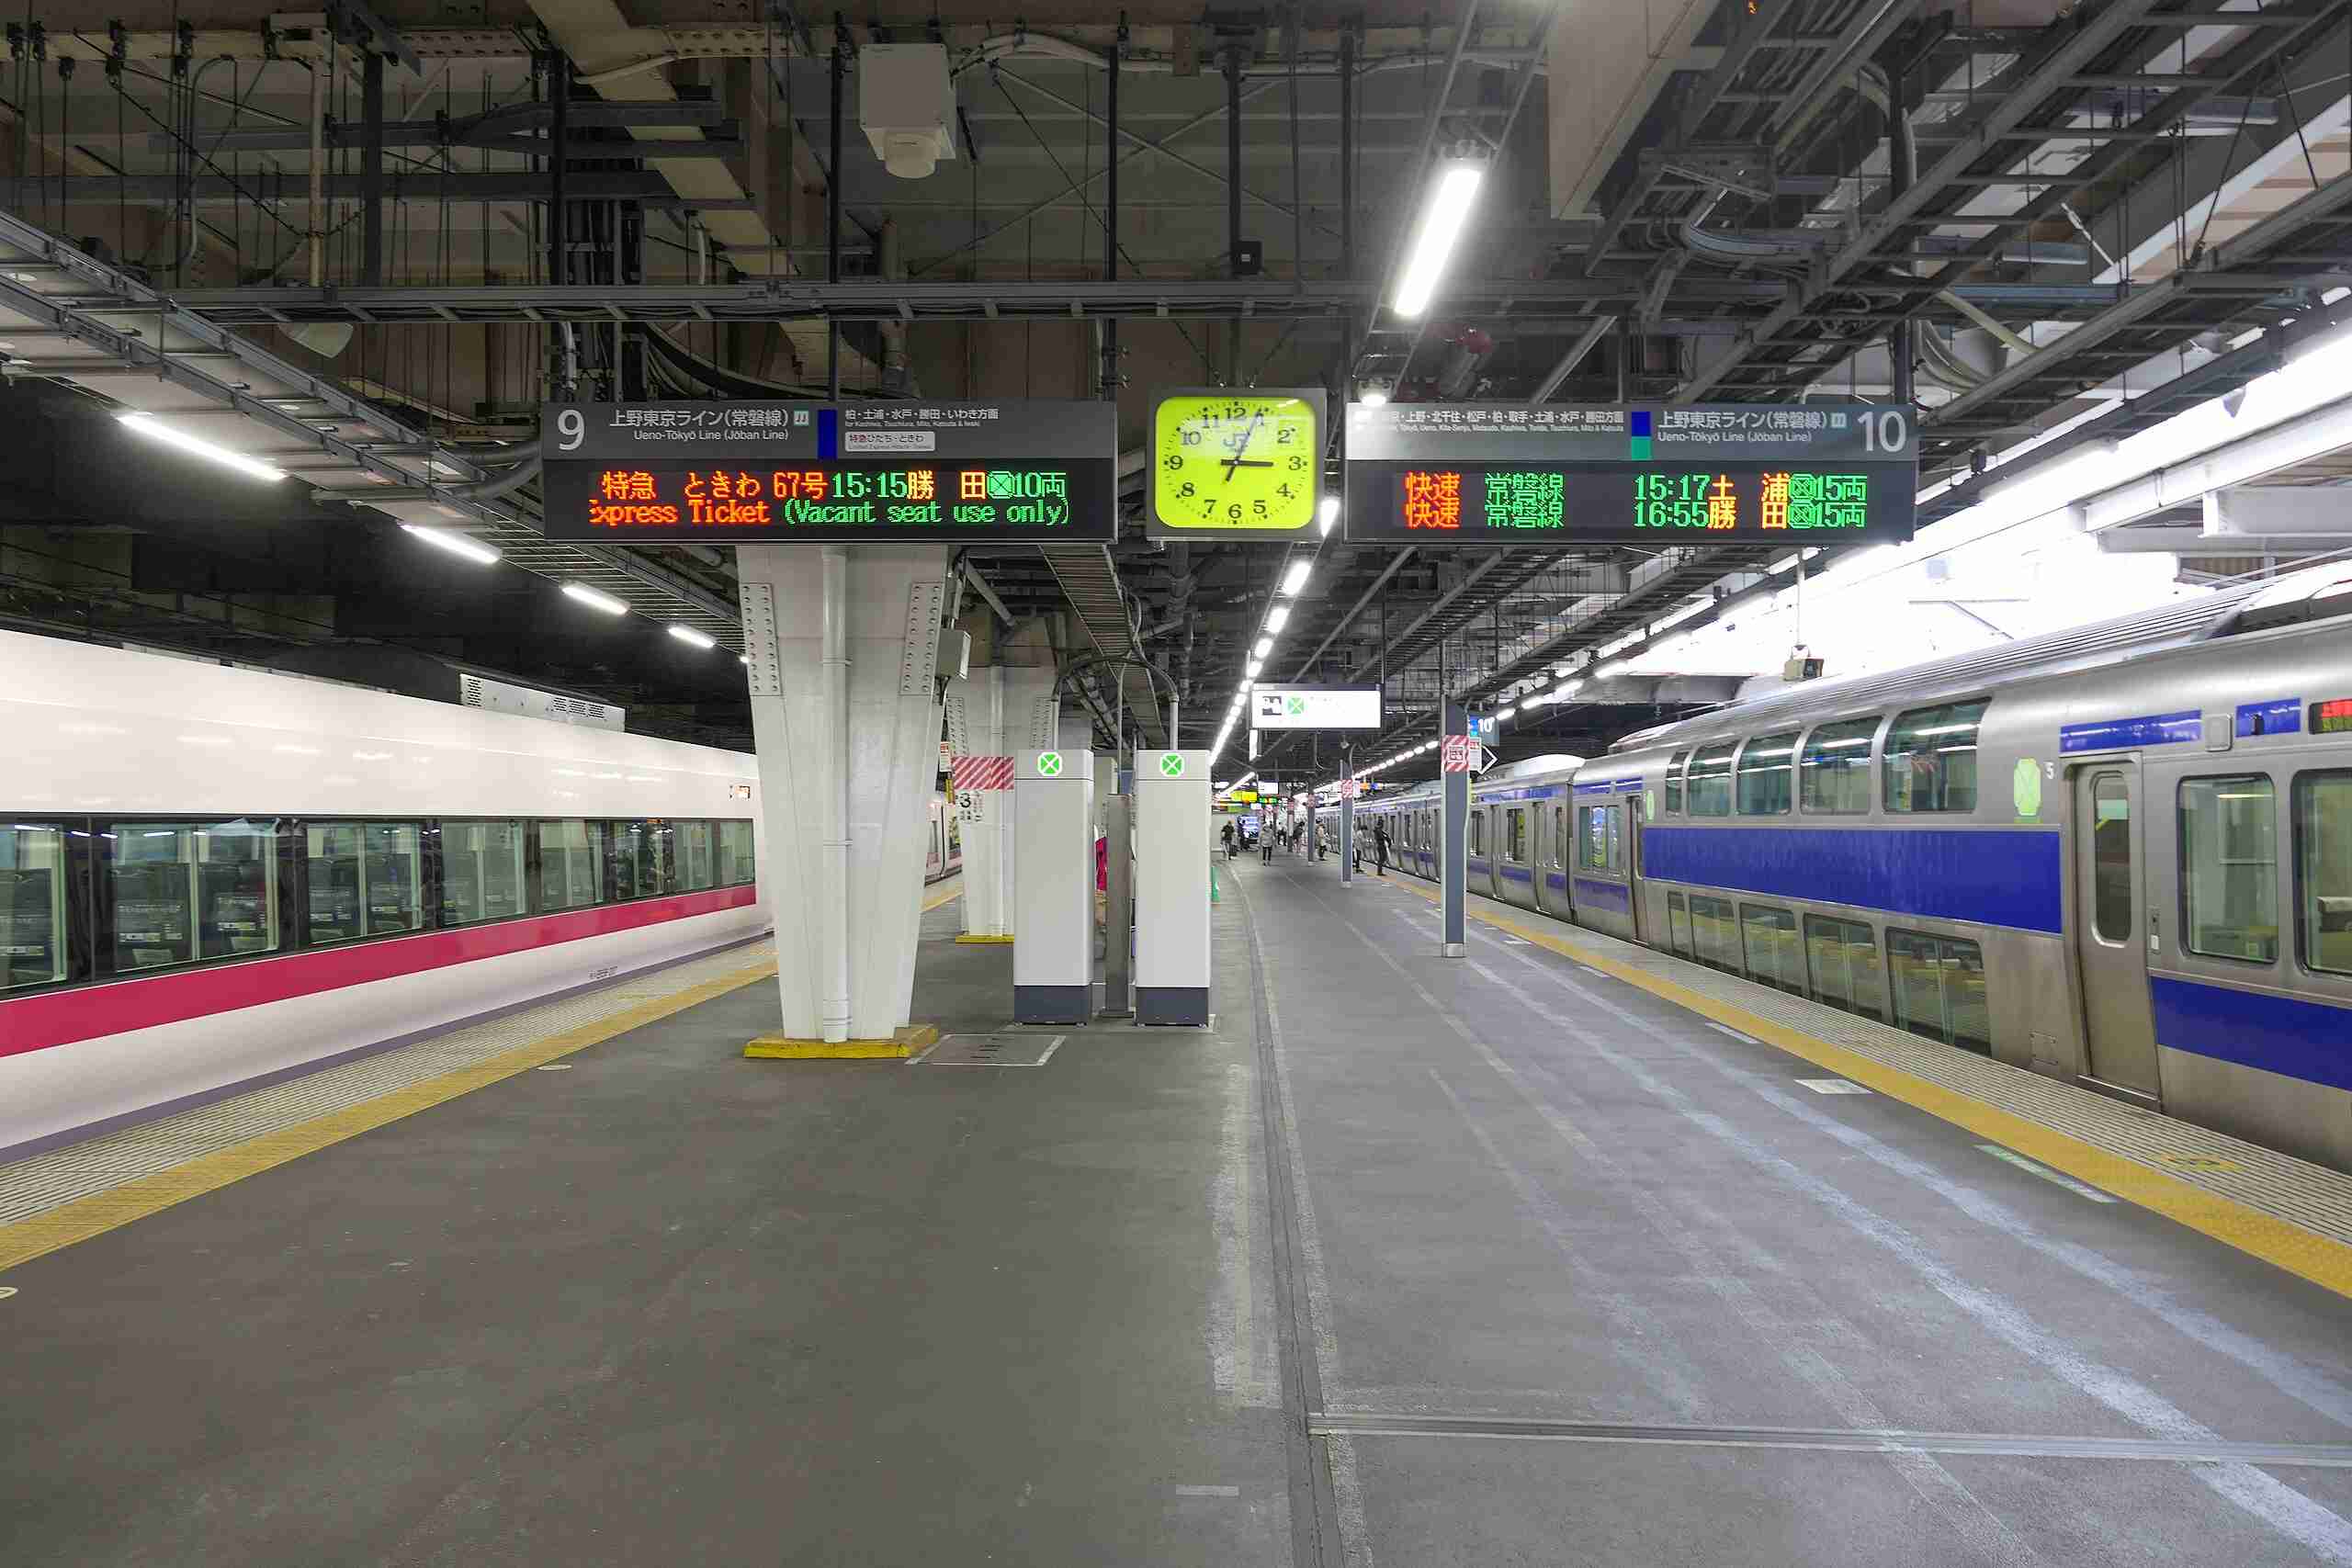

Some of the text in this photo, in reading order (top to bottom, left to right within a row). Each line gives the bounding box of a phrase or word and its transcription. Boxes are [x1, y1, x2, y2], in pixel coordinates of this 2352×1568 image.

[1225, 407, 1247, 420] 12
[1202, 414, 1220, 428] 11
[558, 410, 585, 450] 9
[699, 430, 721, 440] Line
[763, 429, 788, 441] Line)
[1277, 429, 1291, 444] 2
[1858, 411, 1906, 452] 10
[1182, 431, 1202, 446] 10
[1723, 433, 1745, 442] Line
[1786, 432, 1812, 443] Line)
[1170, 456, 1183, 469] 9
[1288, 457, 1302, 470] 3
[602, 471, 656, 500] 特急
[684, 471, 761, 499] ときわ
[831, 471, 907, 499] 15:15
[1182, 482, 1194, 497] 8
[1276, 483, 1292, 497] 4
[1405, 471, 1461, 501] 快速
[689, 500, 771, 524] Ticket
[784, 498, 876, 525] (Vacant
[888, 502, 943, 523] seat
[954, 505, 997, 523] use
[1006, 497, 1071, 525] only)
[1204, 499, 1216, 513] 7
[1228, 504, 1242, 518] 6
[1253, 500, 1266, 513] 5
[1405, 501, 1461, 529] 快速
